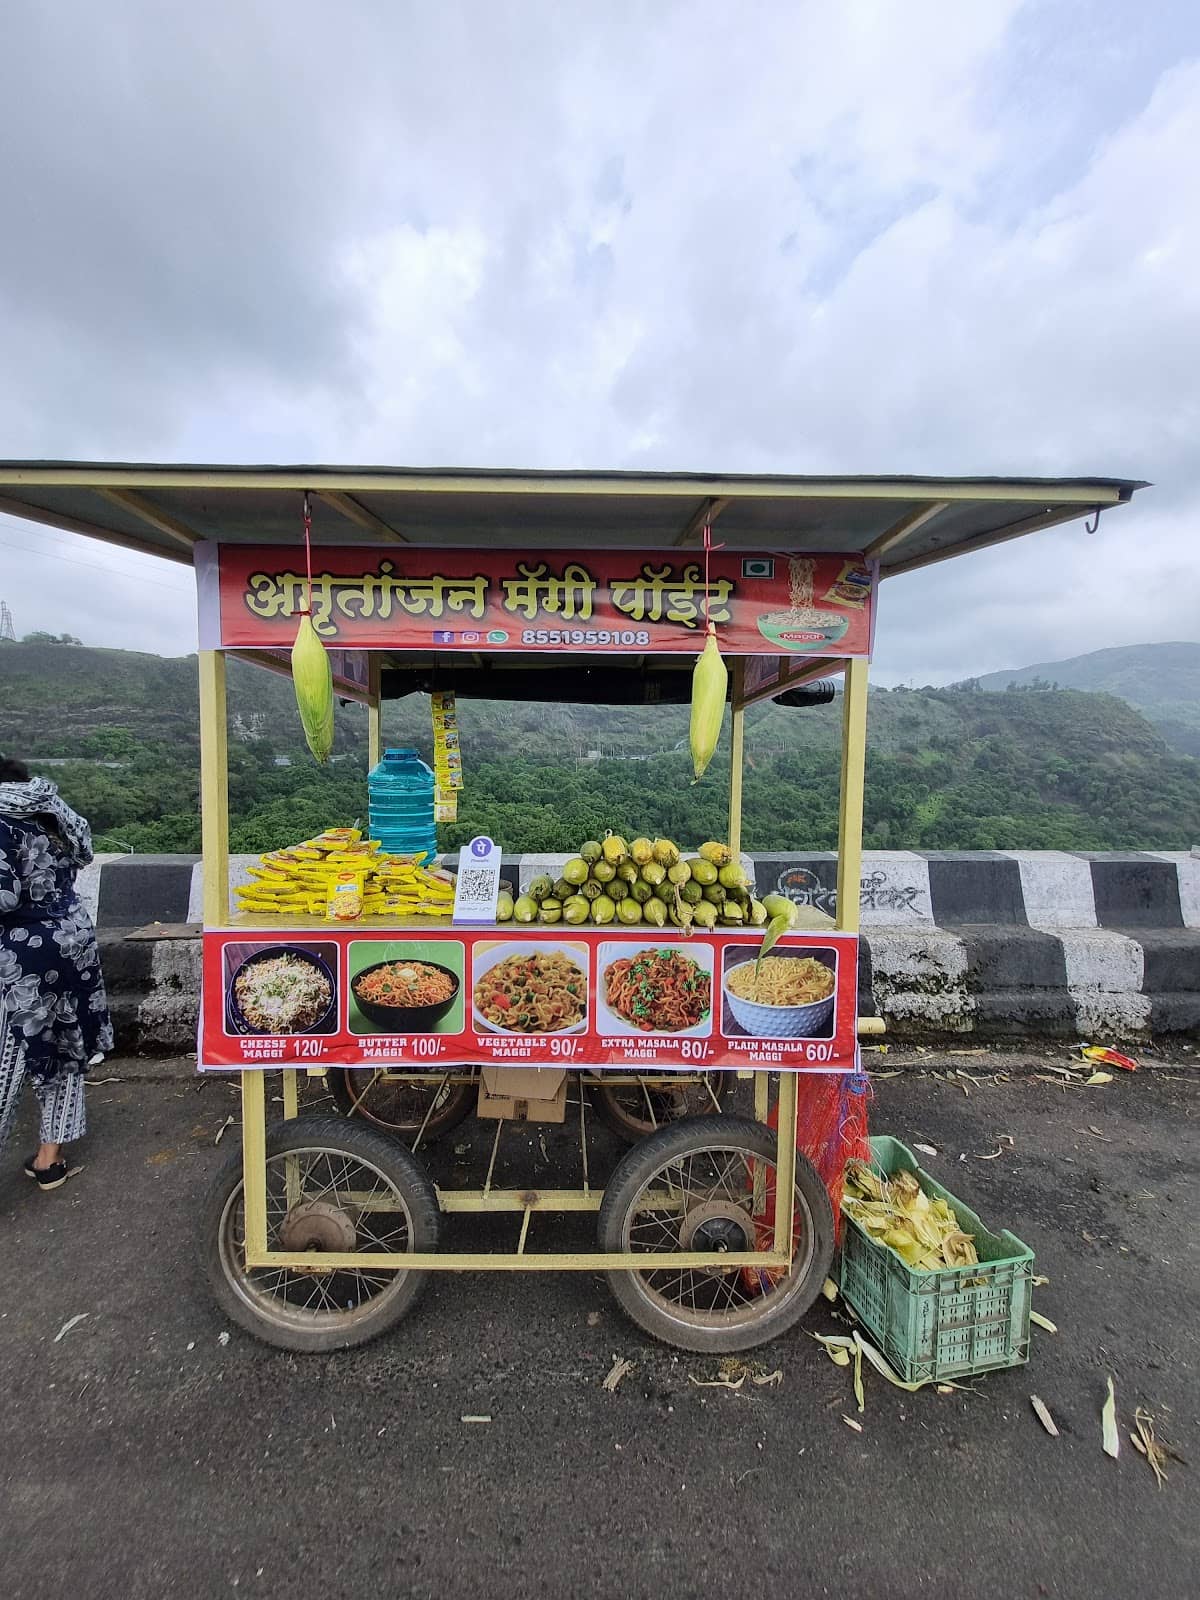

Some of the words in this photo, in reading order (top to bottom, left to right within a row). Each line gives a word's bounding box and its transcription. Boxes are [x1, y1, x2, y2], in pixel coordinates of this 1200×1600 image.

[502, 564, 597, 620] मॅगी
[522, 630, 650, 645] 8551959108
[239, 1039, 287, 1049] CHEESE
[358, 1038, 407, 1048] BUTTER
[411, 1037, 446, 1056] 100/-
[477, 1038, 547, 1047] VEGETABLE
[601, 1039, 635, 1047] EXTRA
[637, 1039, 680, 1048] MASALA
[727, 1041, 759, 1050] PLAIN
[761, 1042, 803, 1052] MASALA
[293, 1039, 329, 1057] 120/-
[363, 1048, 403, 1057] MAGGI
[492, 1047, 531, 1057] MAGGI
[550, 1039, 584, 1057] 90/-
[624, 1048, 657, 1058] MAGGI
[681, 1040, 715, 1059] 80/-
[806, 1043, 840, 1062] 60/-
[243, 1049, 284, 1058] MAGGI
[749, 1052, 782, 1062] MAGGI
